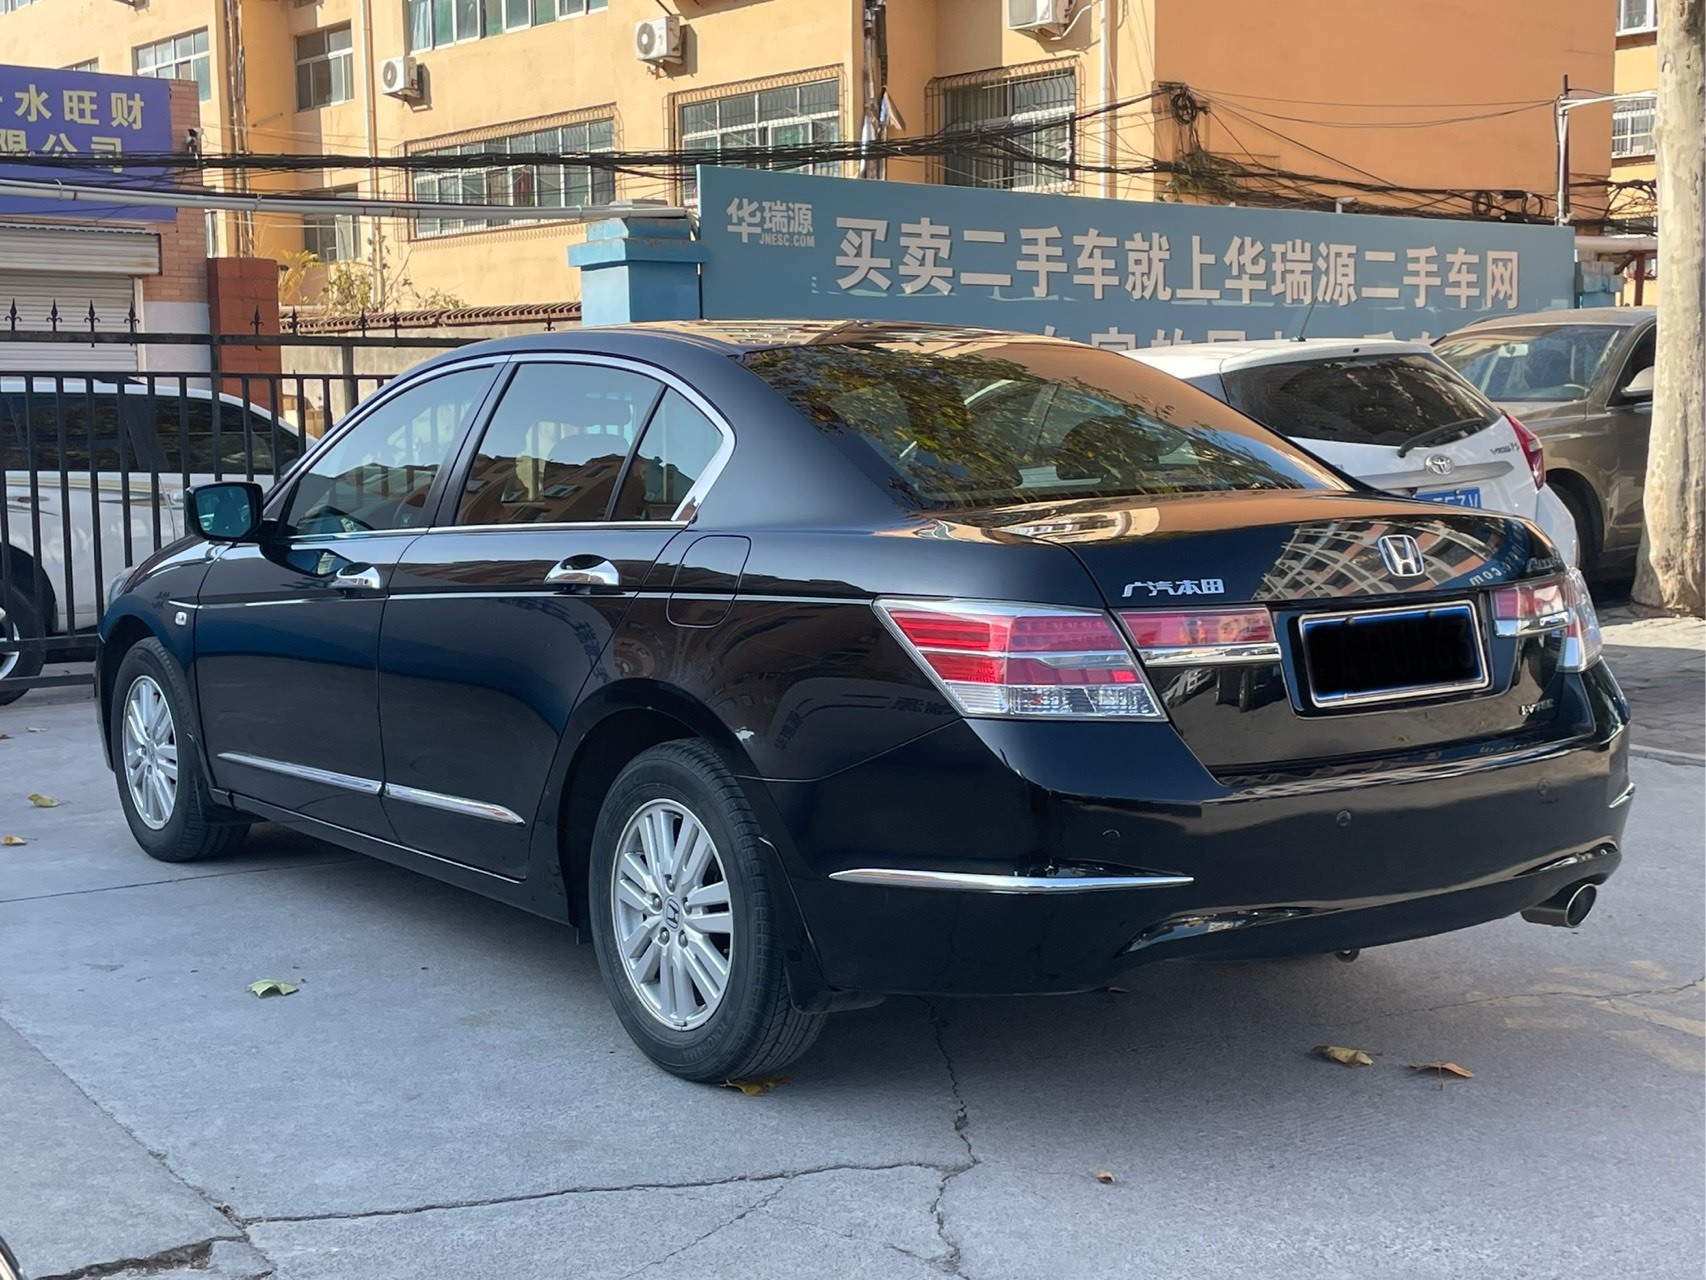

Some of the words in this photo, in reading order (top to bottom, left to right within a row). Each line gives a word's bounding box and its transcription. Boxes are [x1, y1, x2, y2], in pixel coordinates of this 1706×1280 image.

[0, 83, 145, 130] 水旺财
[726, 197, 813, 244] 华瑞源
[759, 233, 815, 248] JNESC.COM
[835, 216, 1520, 310] 买卖二手车就上华瑞源二手车网
[1121, 578, 1225, 598] 广汽本田
